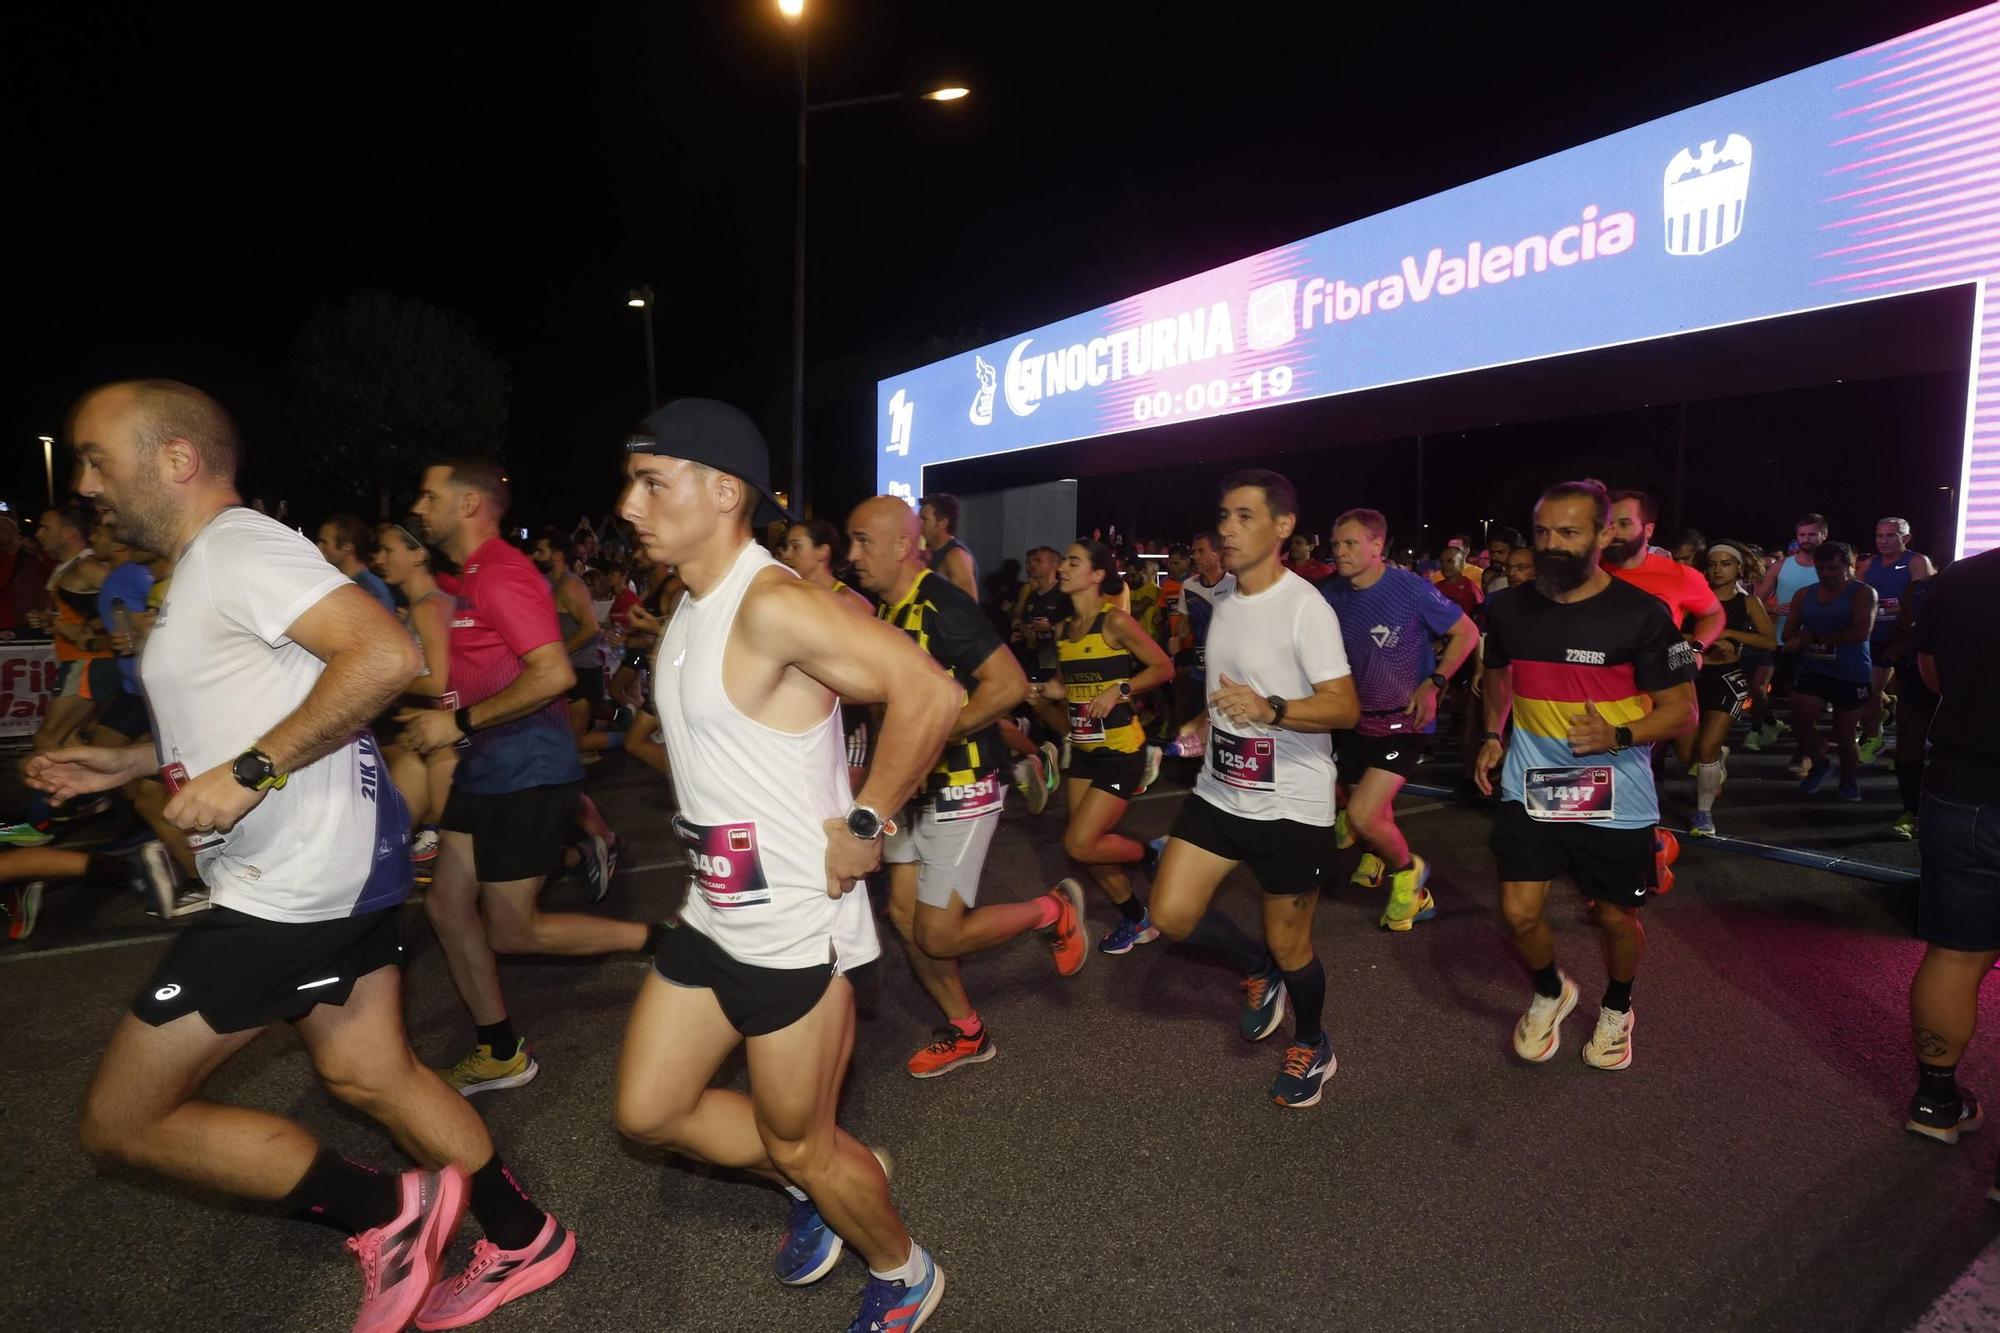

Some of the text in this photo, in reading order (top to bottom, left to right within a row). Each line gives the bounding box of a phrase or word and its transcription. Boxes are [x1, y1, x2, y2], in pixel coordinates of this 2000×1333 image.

[1046, 302, 1235, 397] NOCTURNA
[1133, 365, 1293, 421] 00:00:19
[1566, 648, 1606, 665] 226ERS
[1667, 640, 1692, 658] 226ER
[1218, 749, 1259, 771] 1254
[942, 779, 993, 801] 10531
[1545, 786, 1595, 801] 1417
[688, 848, 732, 878] 940
